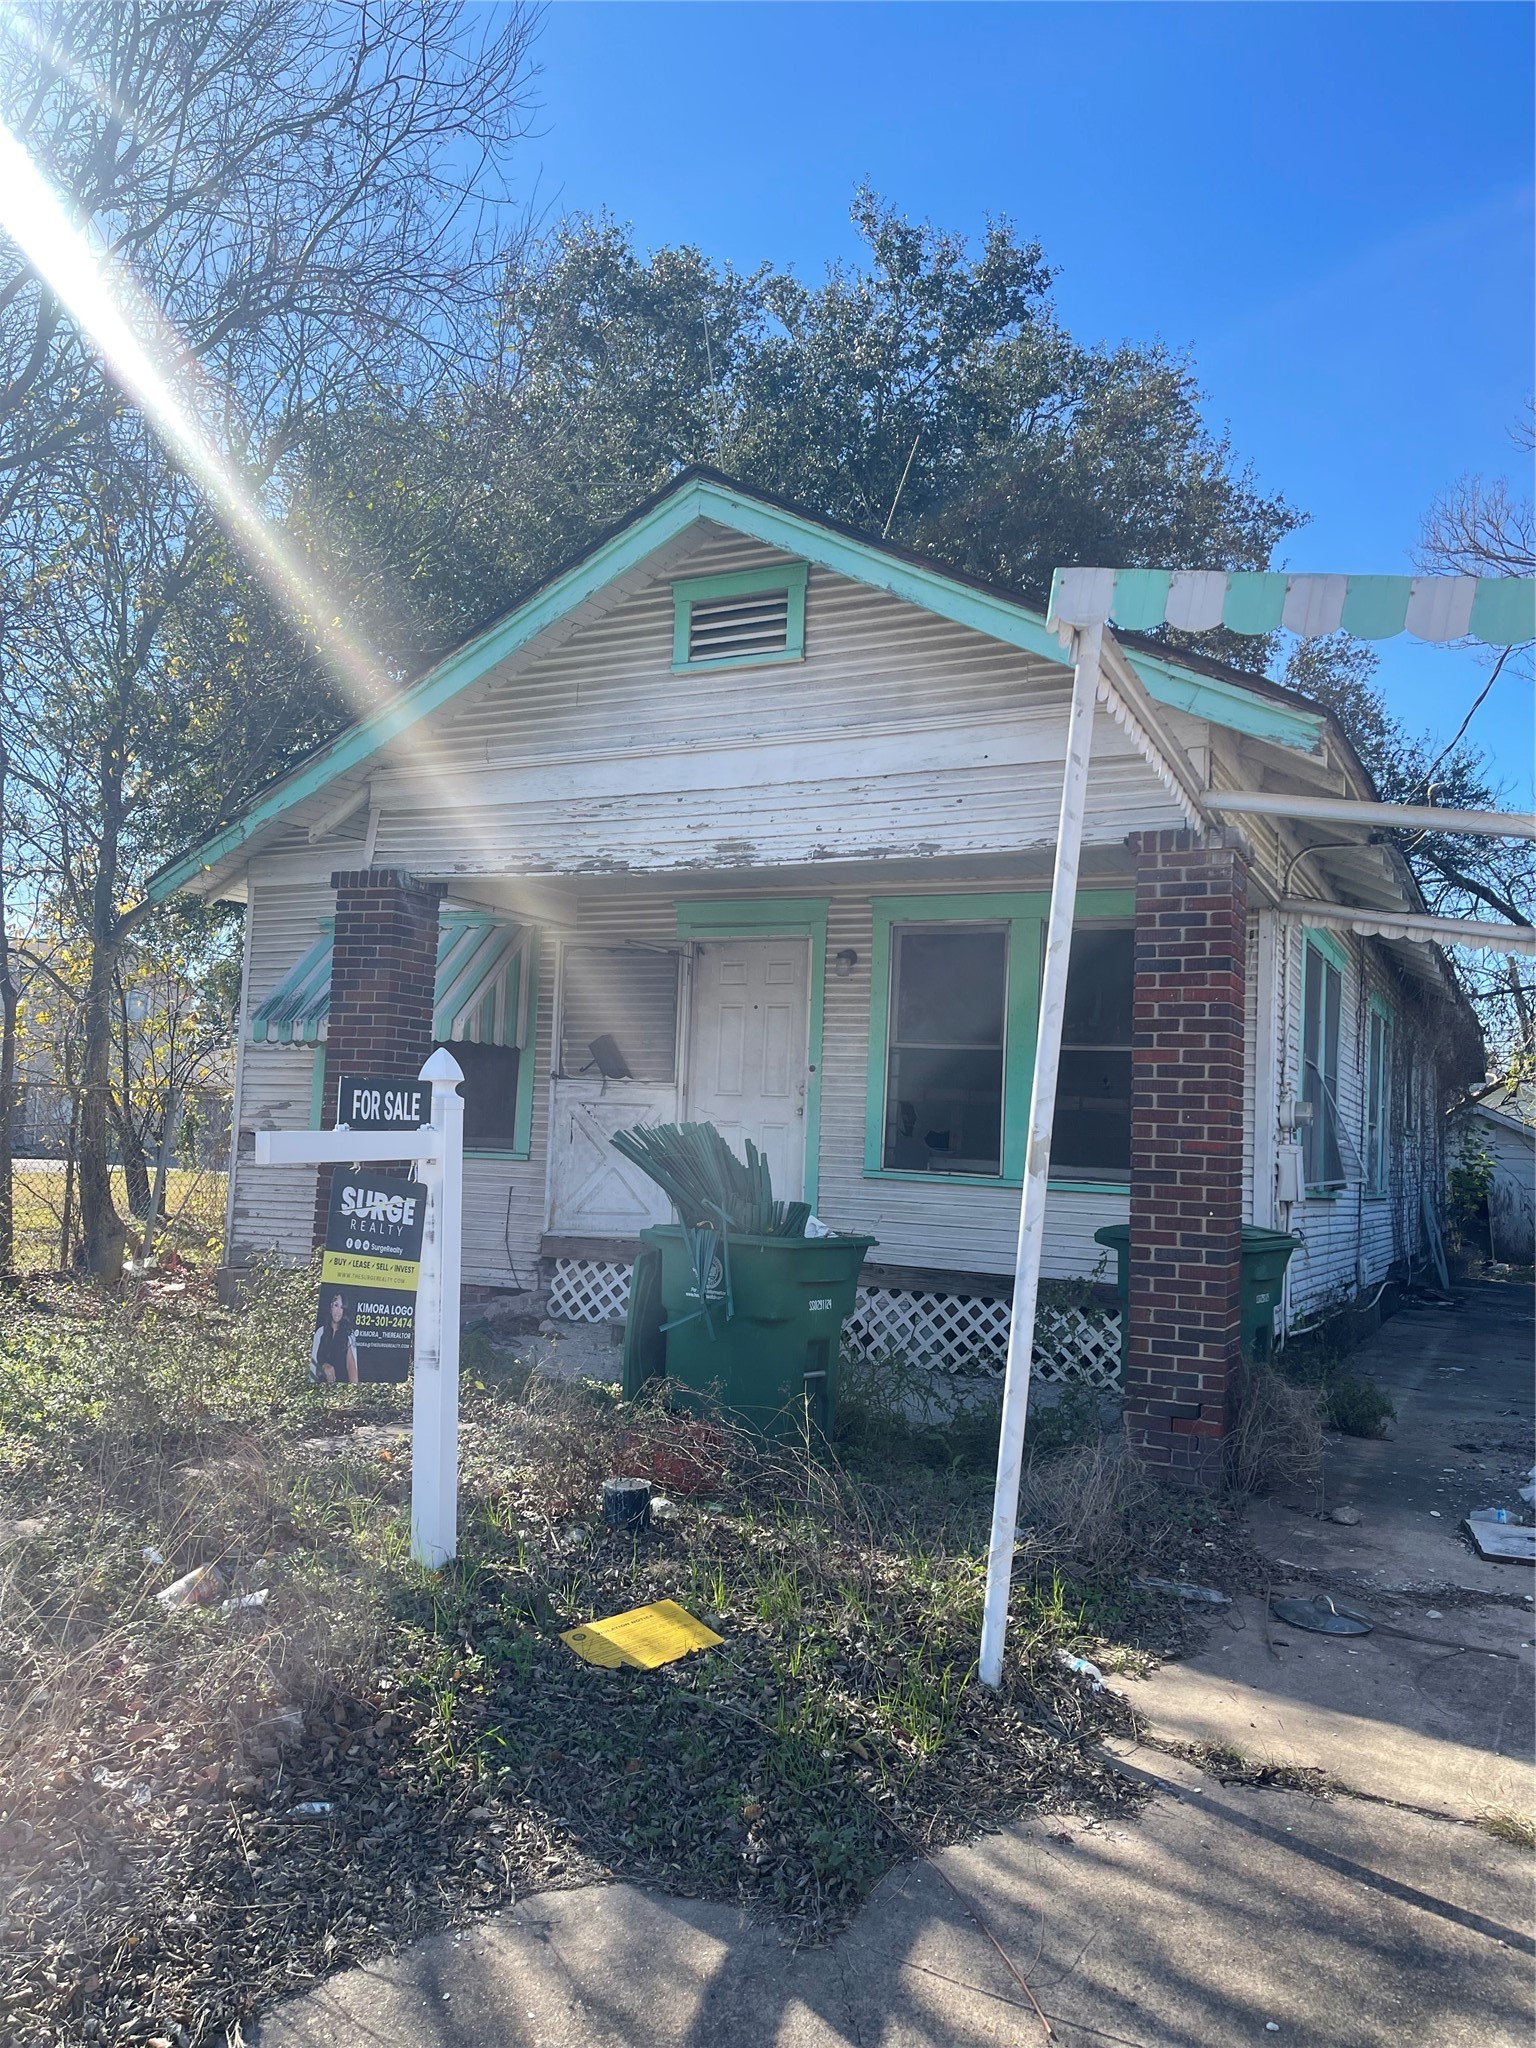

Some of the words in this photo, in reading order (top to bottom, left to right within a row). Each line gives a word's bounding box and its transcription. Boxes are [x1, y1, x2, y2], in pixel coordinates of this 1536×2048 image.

[352, 1089, 381, 1120] FOR
[383, 1091, 421, 1121] SALE
[340, 1186, 417, 1226] SURGE
[350, 1219, 404, 1237] REALTY
[370, 1243, 404, 1256] SurgeRealty
[333, 1257, 347, 1266] BUY
[352, 1259, 371, 1269] LEASE
[375, 1262, 389, 1271] SELL
[393, 1264, 415, 1274] INVEST
[357, 1302, 390, 1315] KIMORA
[391, 1304, 413, 1316] LOGO
[355, 1314, 413, 1328] 832-301-2474
[631, 1614, 655, 1625] NOTICE
